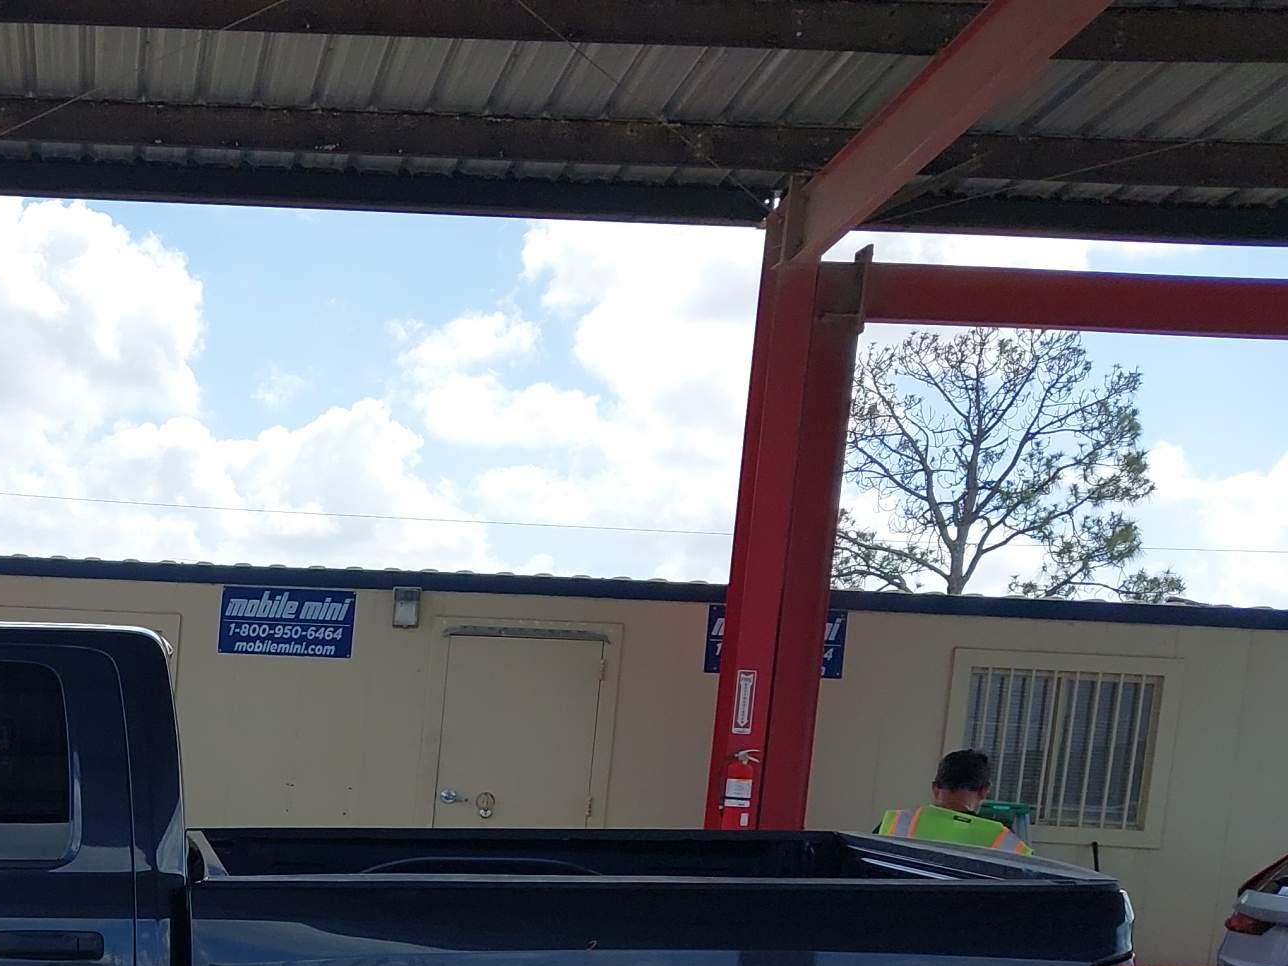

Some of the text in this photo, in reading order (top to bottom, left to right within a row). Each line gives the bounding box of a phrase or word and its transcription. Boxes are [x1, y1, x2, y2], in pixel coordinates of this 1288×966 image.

[224, 590, 352, 621] mobile mini
[228, 623, 344, 641] 1-800-950-6464
[233, 639, 336, 656] mobilemini.com
